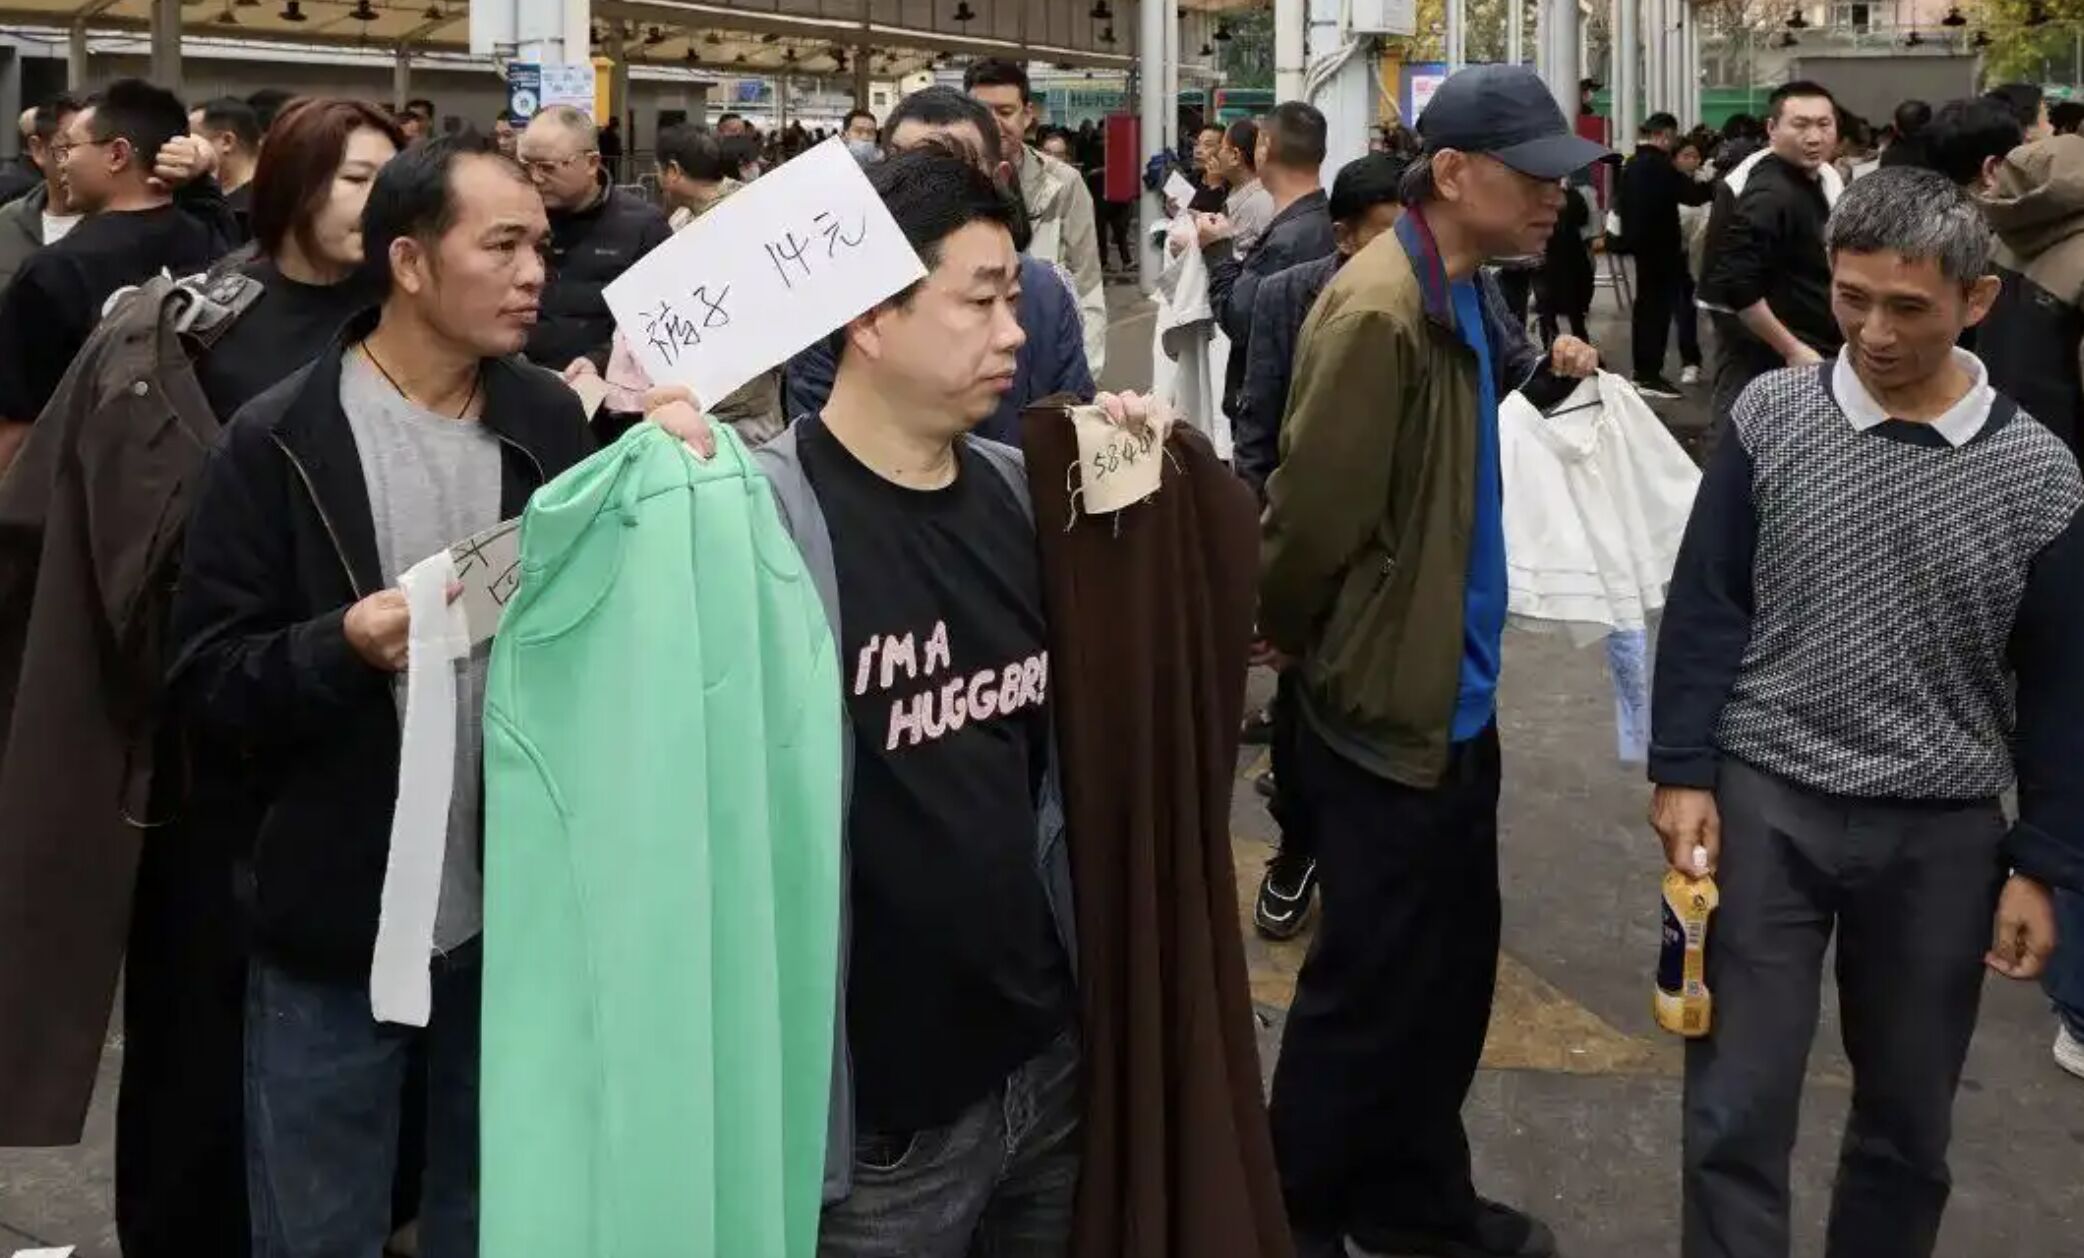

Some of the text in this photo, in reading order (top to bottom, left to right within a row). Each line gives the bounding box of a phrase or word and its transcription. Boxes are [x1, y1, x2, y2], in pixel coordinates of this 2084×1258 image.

[764, 211, 867, 288] 14元
[855, 619, 950, 695] I'M A
